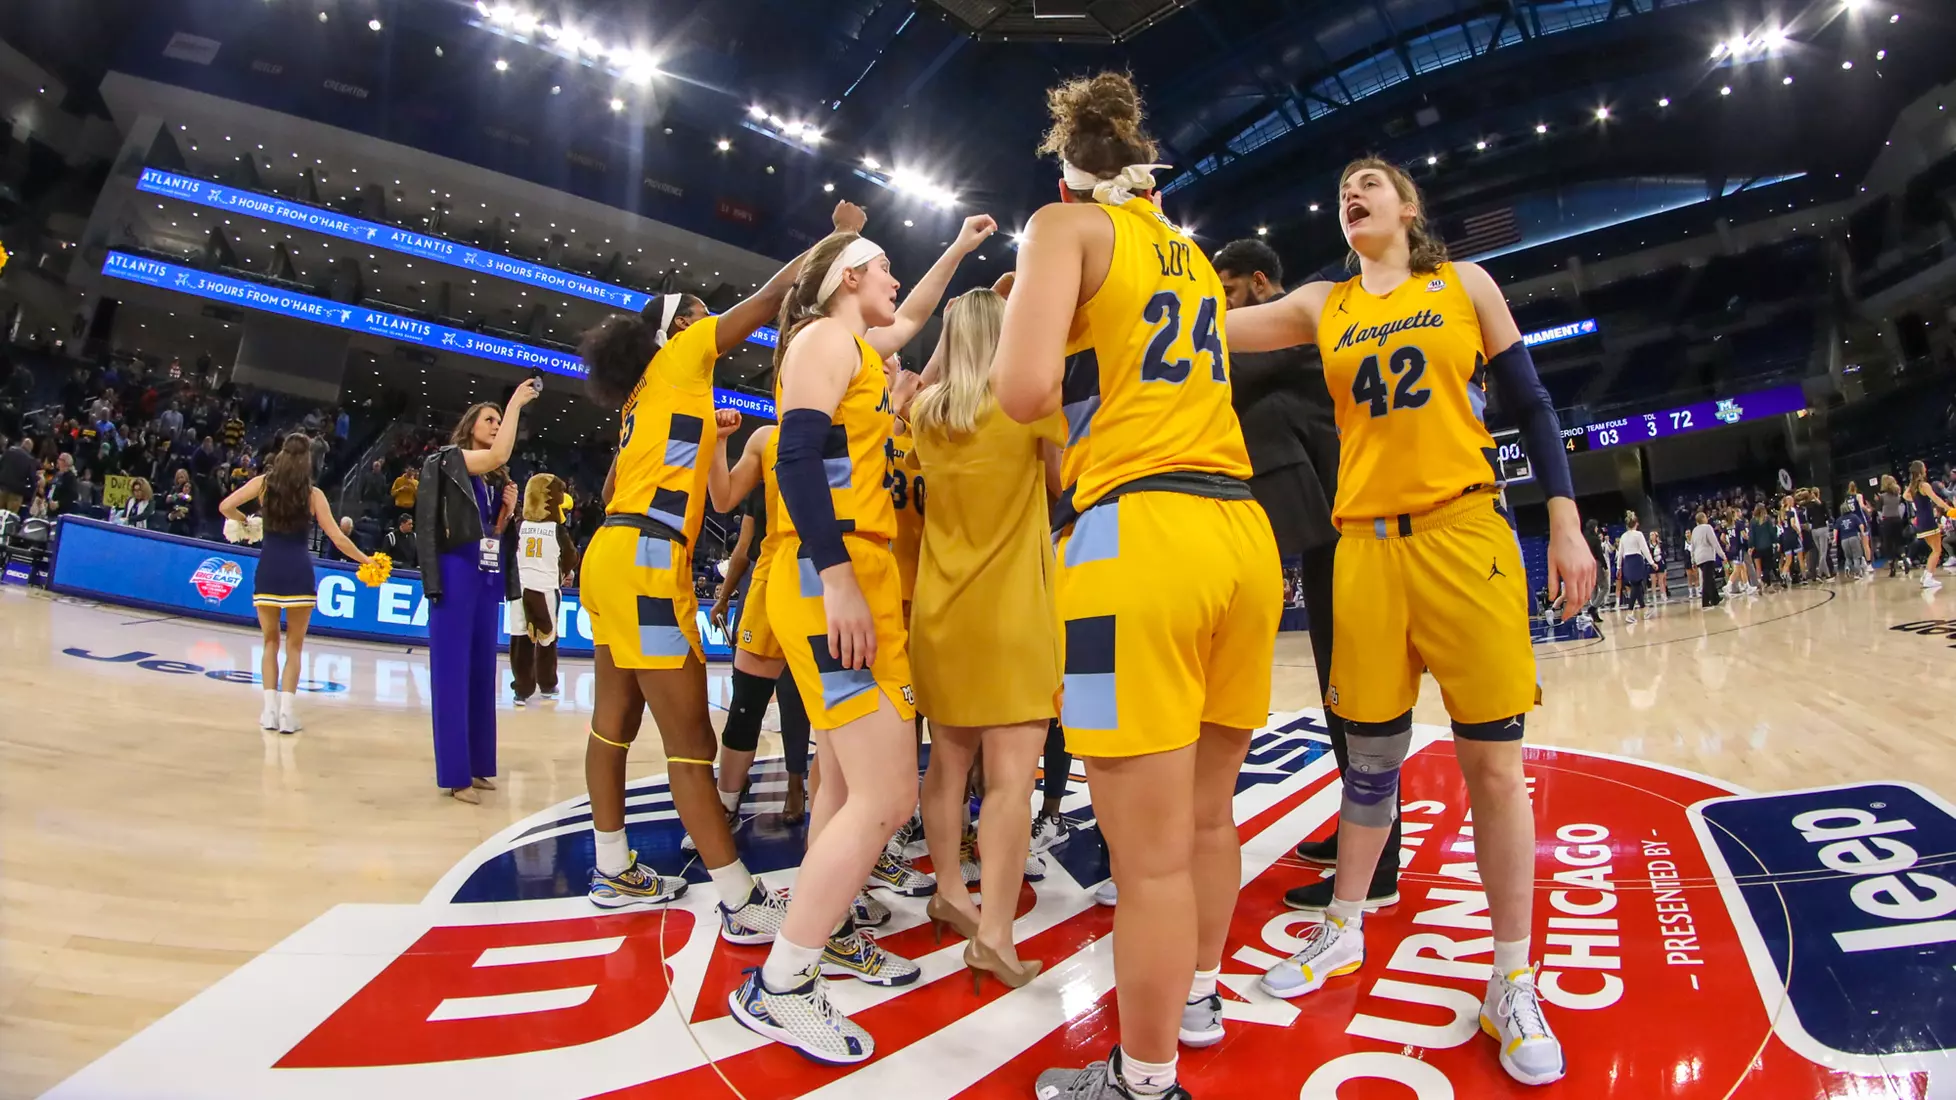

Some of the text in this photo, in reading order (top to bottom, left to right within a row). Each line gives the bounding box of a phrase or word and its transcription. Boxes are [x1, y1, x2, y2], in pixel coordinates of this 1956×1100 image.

[142, 172, 200, 193] ATLANTIS
[230, 196, 236, 205] 3
[238, 198, 275, 214] HOURS
[276, 206, 308, 222] FROM
[309, 214, 350, 232] O'HARE
[390, 232, 454, 254] ATLANTIS
[486, 258, 494, 268] 3
[496, 262, 532, 278] HOURS
[534, 272, 566, 288] FROM
[568, 280, 606, 298] O'HARE
[106, 256, 166, 276] ATLANTIS
[198, 279, 205, 289] 3
[207, 282, 244, 298] HOURS
[246, 290, 279, 306] FROM
[281, 298, 322, 316] O'HARE
[366, 313, 591, 374] ATLANTIS 3 HOURS FROM O'HARE
[751, 330, 768, 342] URS
[1142, 290, 1227, 385] 24
[1333, 309, 1444, 352] Marquette
[1523, 323, 1580, 346] NAMENT
[1351, 345, 1432, 419] 42
[720, 395, 727, 404] 3
[729, 397, 761, 412] HOURS
[1669, 410, 1694, 430] 72
[1586, 418, 1628, 433] TEAM FOULS
[1599, 430, 1620, 446] 03
[1647, 422, 1658, 436] 3
[1566, 438, 1575, 452] 4
[526, 536, 542, 558] 21
[196, 572, 240, 584] BIG EAST
[62, 647, 347, 692] Jeep
[1537, 823, 1624, 1010] CHICAGO
[1642, 839, 1704, 965] PRESENTED BY
